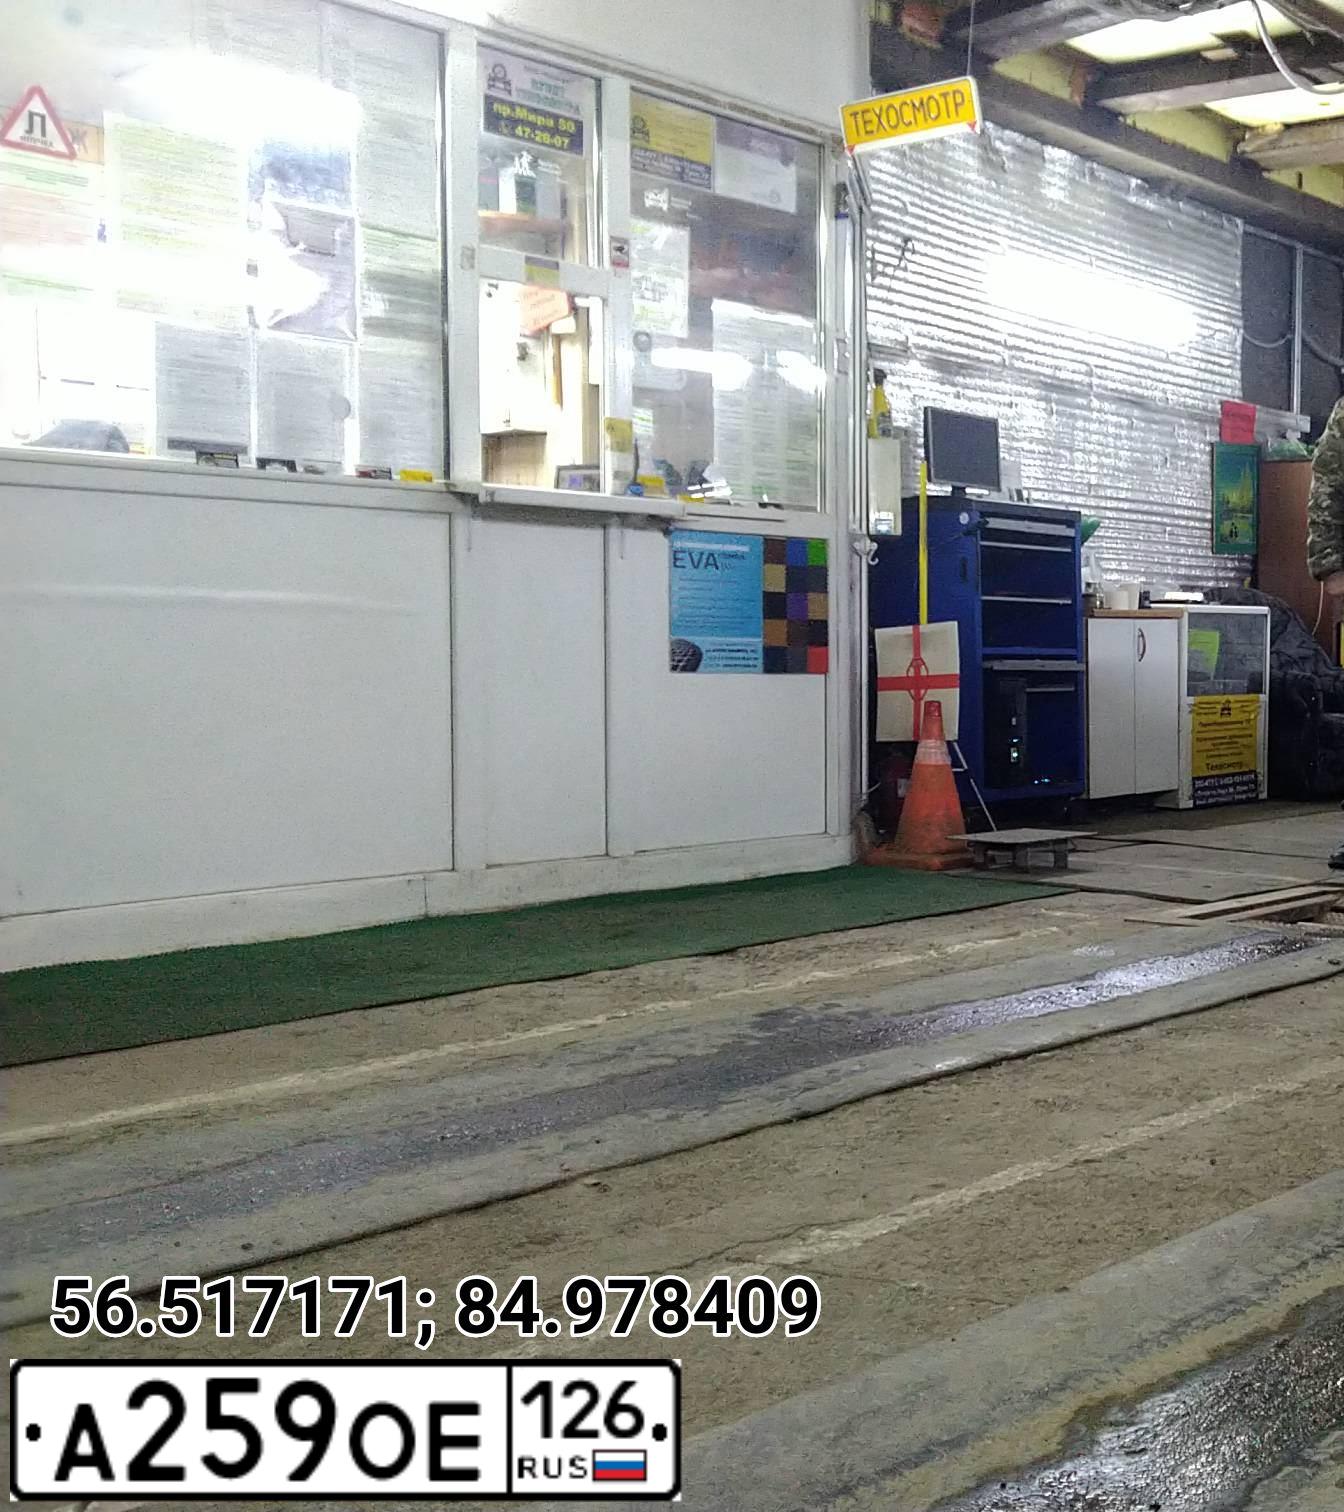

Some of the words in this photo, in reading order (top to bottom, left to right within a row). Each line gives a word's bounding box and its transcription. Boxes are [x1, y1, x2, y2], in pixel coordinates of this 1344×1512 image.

[25, 110, 47, 138] Л
[850, 89, 966, 137] ТЕХОСМОТР
[672, 549, 719, 570] EVA
